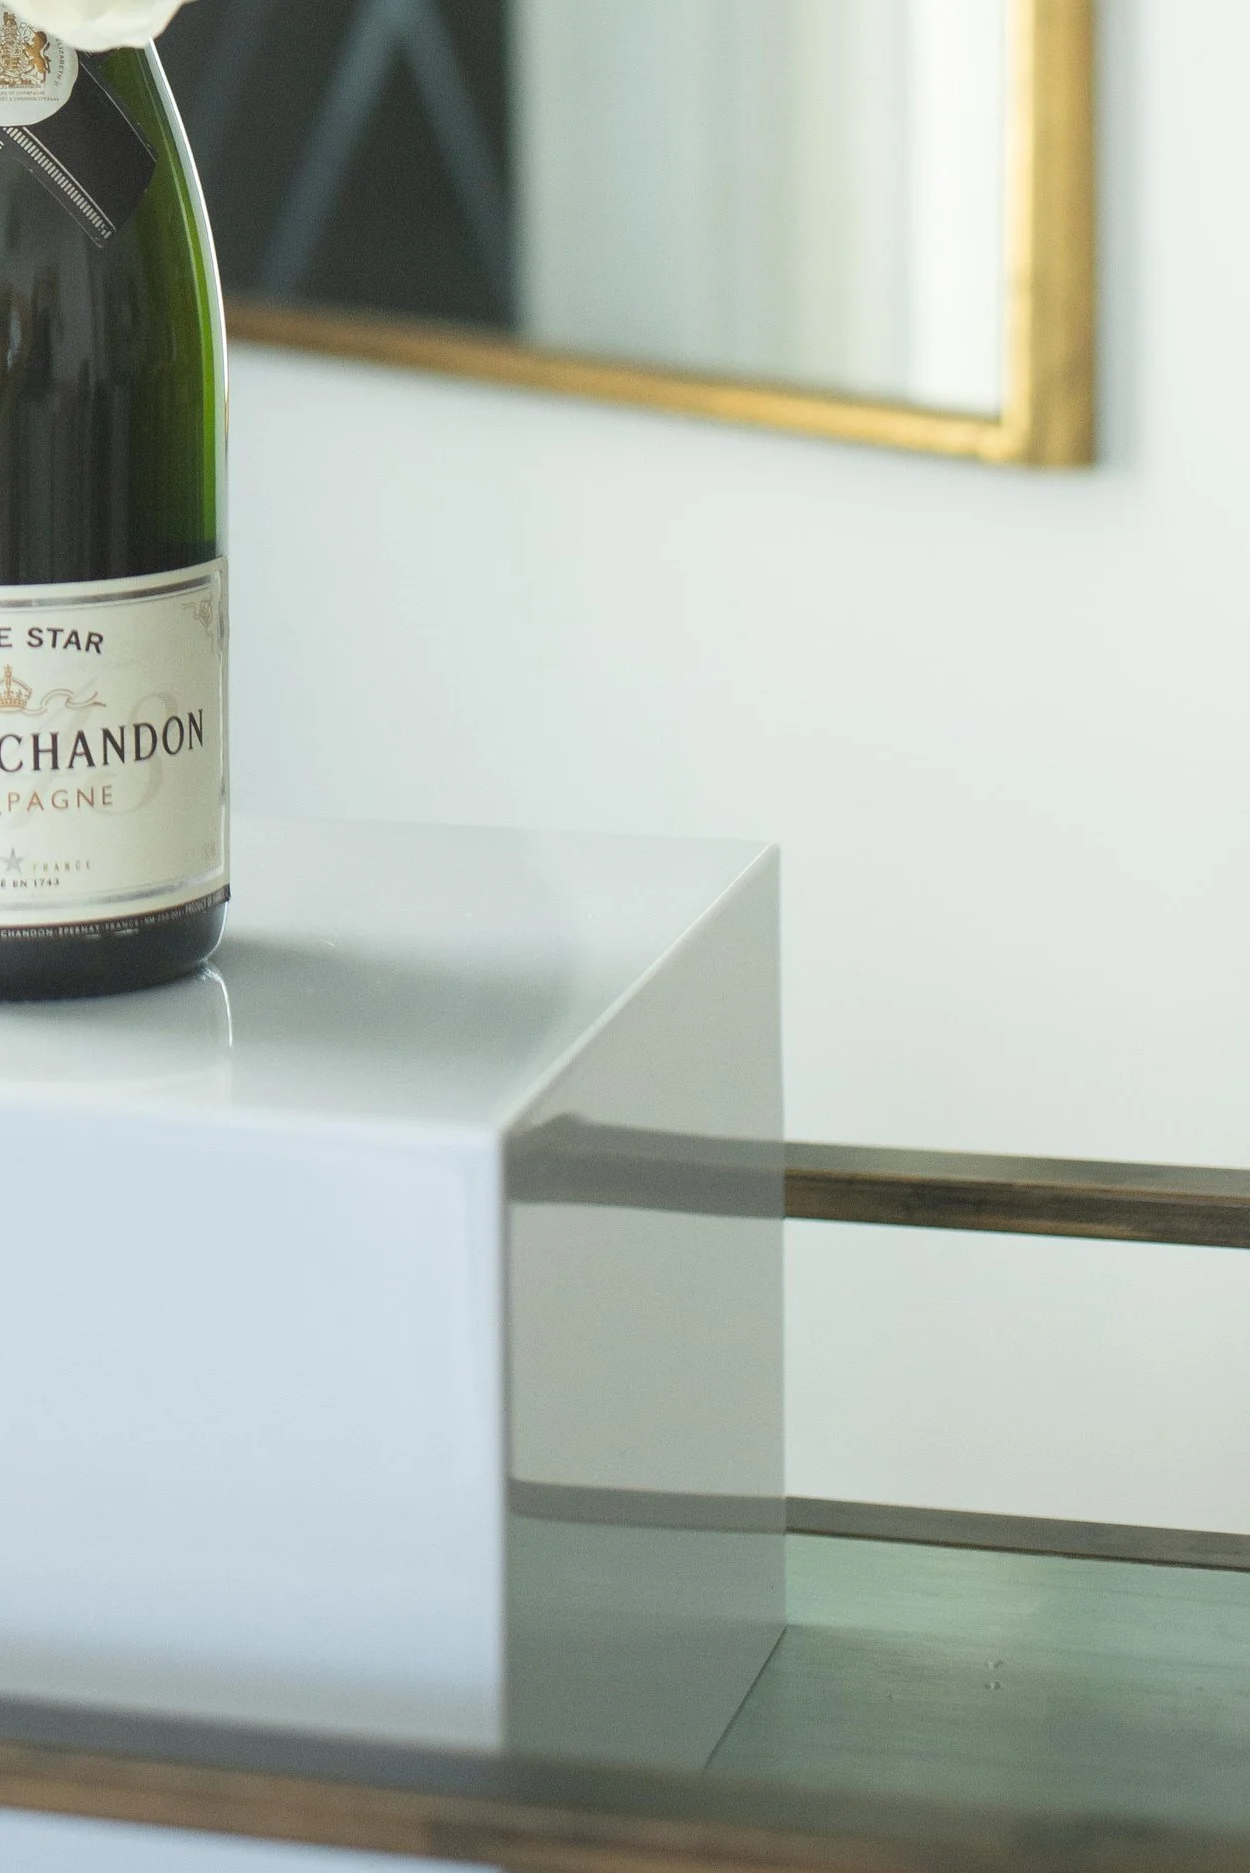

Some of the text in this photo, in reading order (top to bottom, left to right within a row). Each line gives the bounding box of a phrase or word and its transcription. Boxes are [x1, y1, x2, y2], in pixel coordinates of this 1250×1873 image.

[26, 626, 104, 654] STAR
[32, 859, 91, 874] FRANCE
[12, 879, 28, 889] EN
[0, 927, 53, 939] CHANDON
